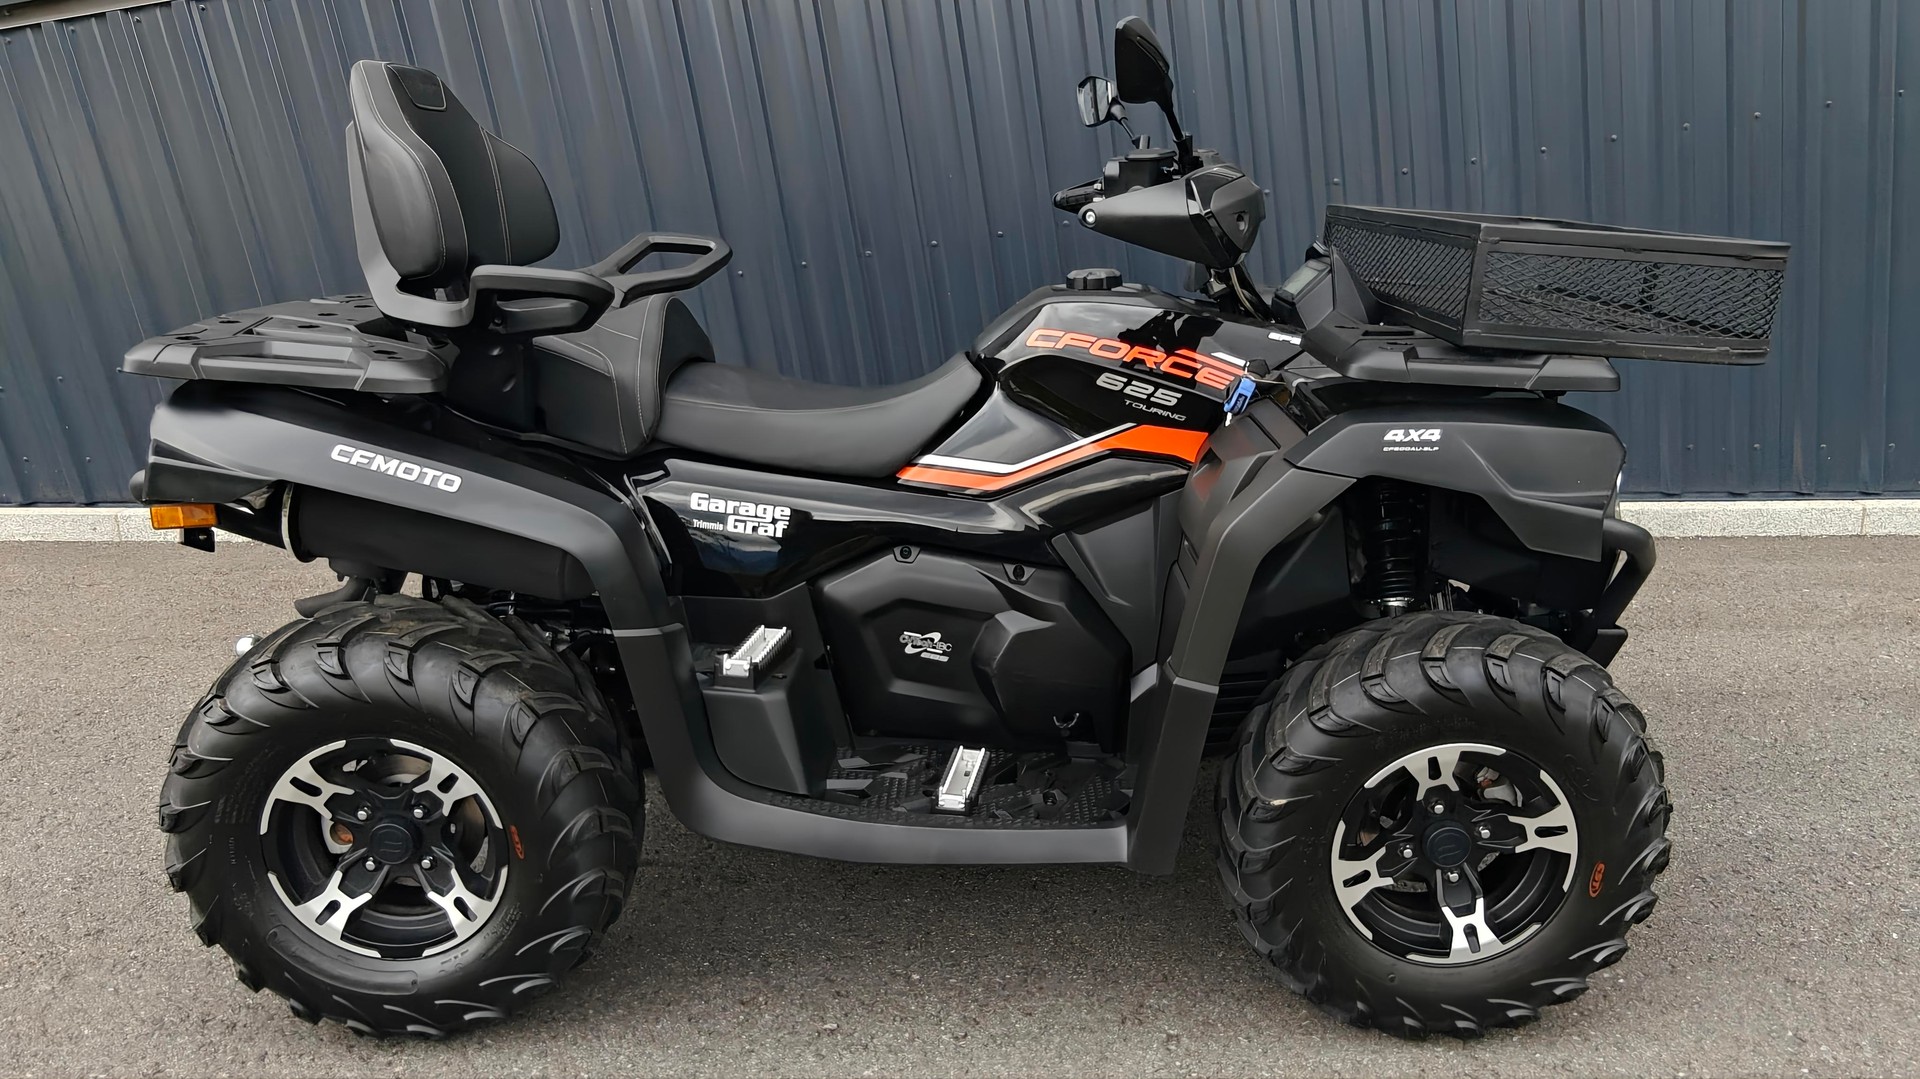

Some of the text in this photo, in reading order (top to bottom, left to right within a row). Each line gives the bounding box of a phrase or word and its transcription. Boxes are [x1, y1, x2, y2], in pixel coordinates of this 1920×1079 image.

[1026, 328, 1245, 390] CFORCE
[1096, 372, 1182, 406] 625
[1124, 400, 1186, 421] TOURING
[1383, 428, 1441, 442] 4X4
[330, 444, 462, 493] CFMOTO
[690, 492, 791, 522] Garage
[693, 515, 789, 537] Trimmis Graf
